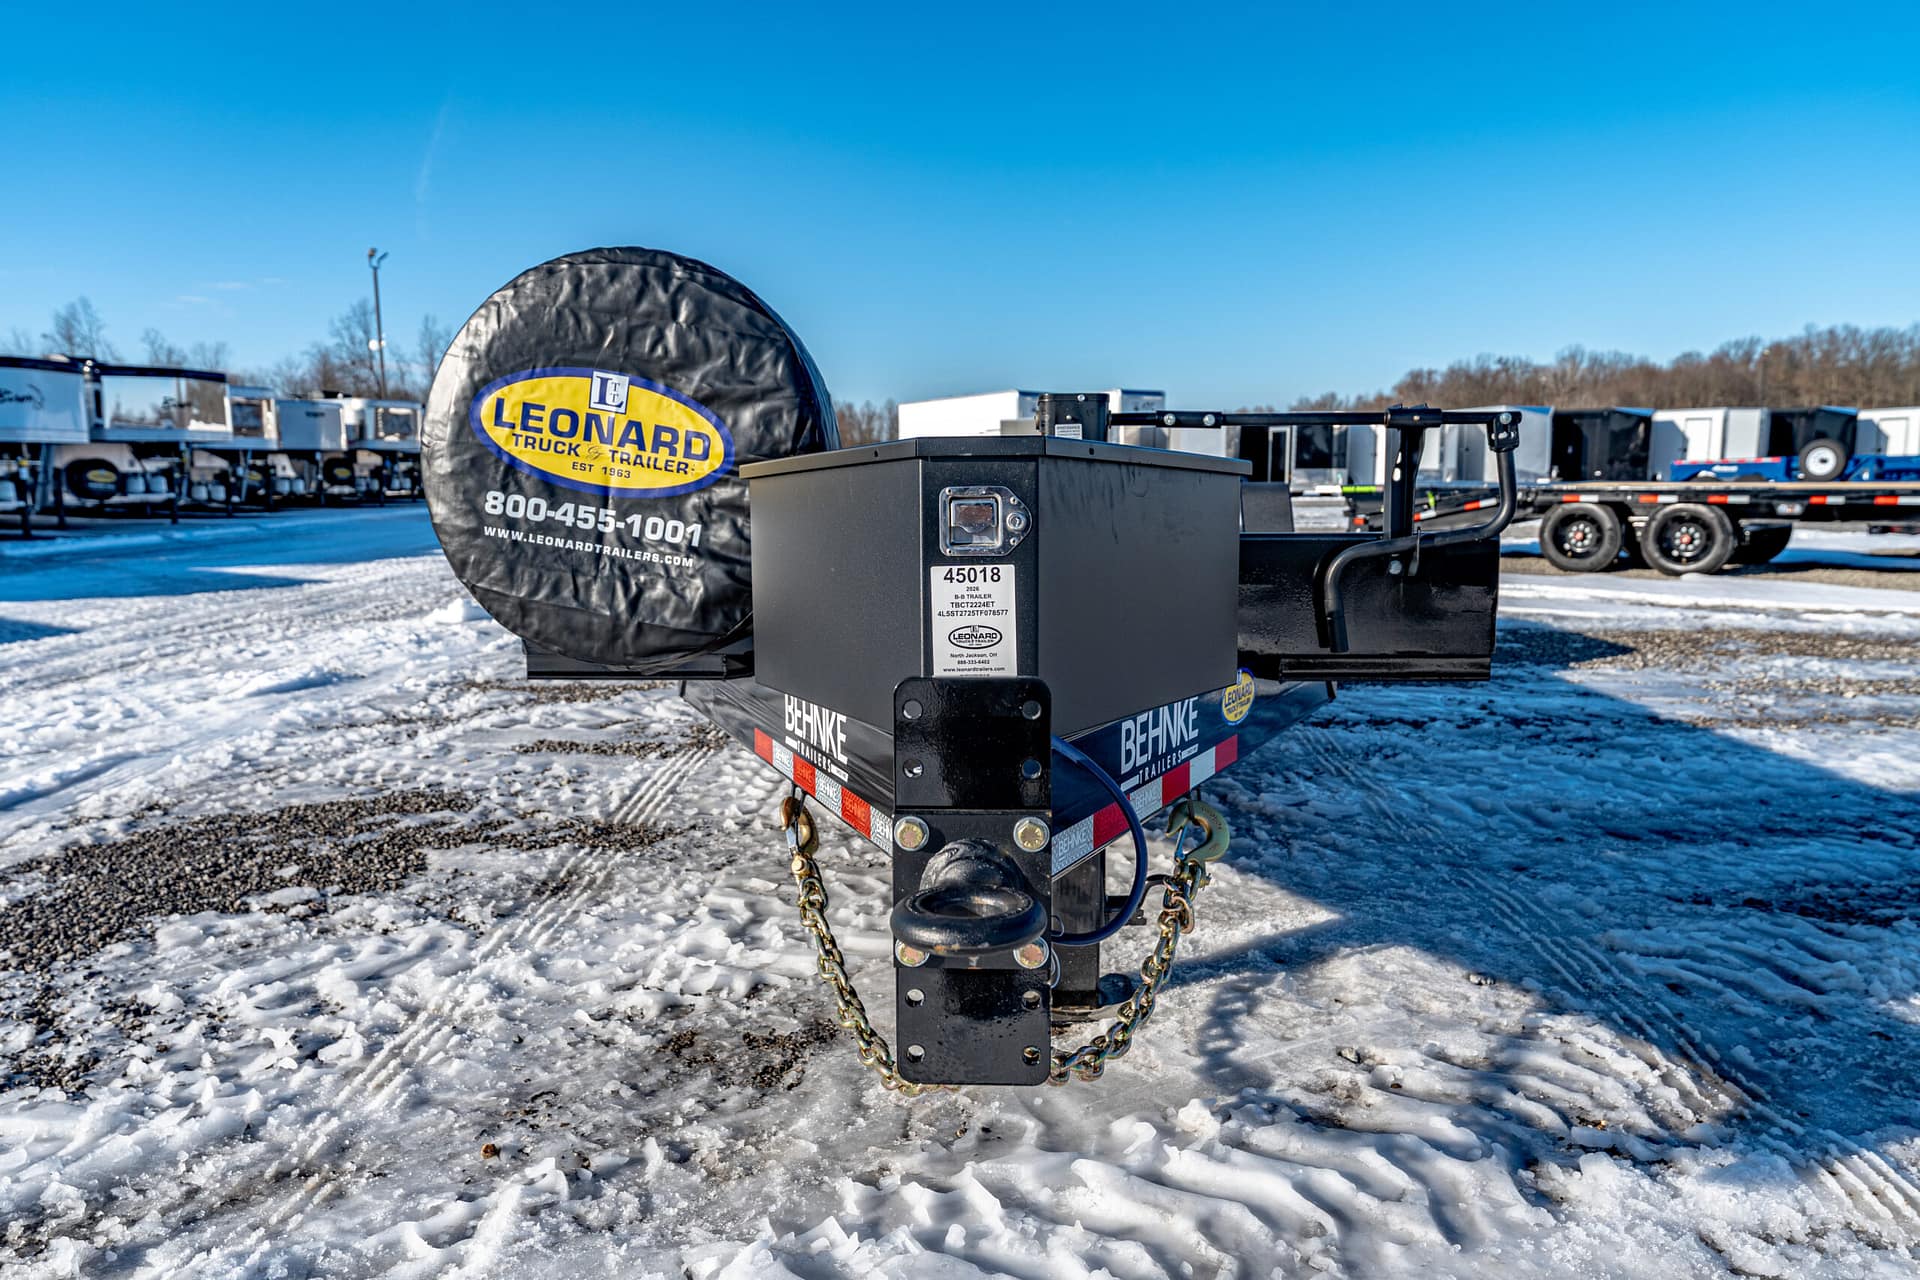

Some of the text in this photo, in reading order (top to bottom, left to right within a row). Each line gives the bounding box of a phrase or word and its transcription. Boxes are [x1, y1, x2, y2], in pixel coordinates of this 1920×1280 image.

[493, 397, 712, 462] LEONARD
[512, 433, 581, 457] TRUCK
[609, 449, 689, 475] TRAILER
[571, 461, 631, 479] EST 1963
[484, 490, 702, 548] 800-455-1001
[484, 526, 694, 568] WWW.LEONARDTRAILERS.COM
[944, 567, 1001, 583] 45018
[1224, 681, 1253, 708] LEONARD
[784, 693, 848, 765] BEHNKE
[1120, 696, 1199, 775] BEHNKE
[797, 740, 832, 773] TRAILERS
[1138, 749, 1183, 785] TRAILERS
[1057, 827, 1089, 857] BEHNKE
